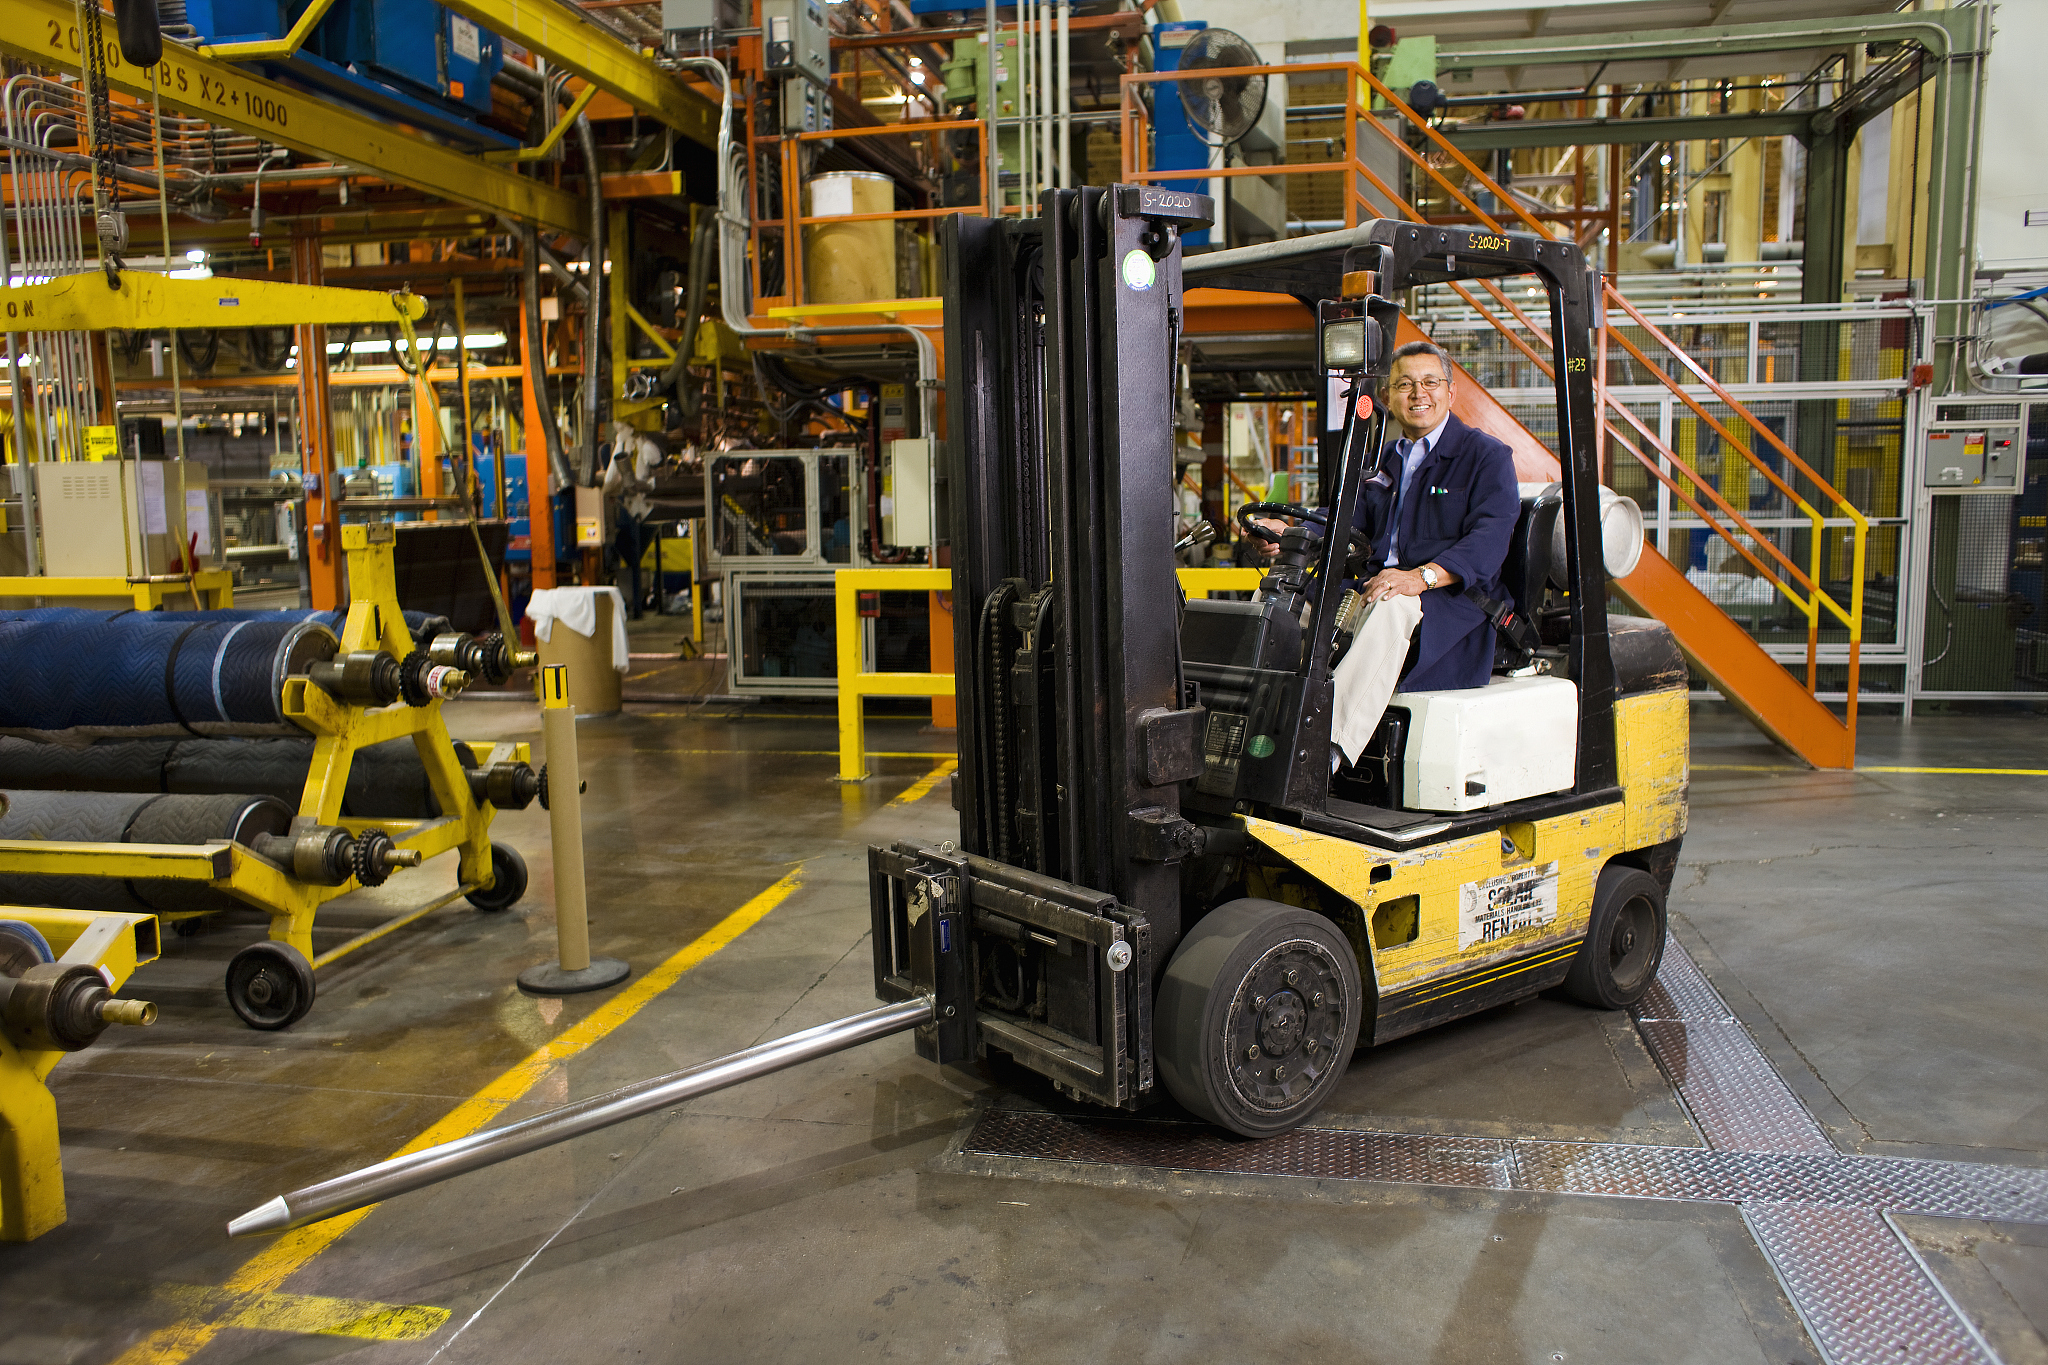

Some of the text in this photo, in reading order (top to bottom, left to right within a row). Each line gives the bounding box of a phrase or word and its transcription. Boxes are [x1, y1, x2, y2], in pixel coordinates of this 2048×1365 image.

[47, 19, 120, 69] 200
[1143, 192, 1191, 208] S-2020
[1468, 232, 1511, 252] S-2020-T
[0, 299, 34, 318] ON
[1567, 357, 1586, 373] #23
[1479, 870, 1535, 890] XCLUSIVE ROPERTY
[1475, 908, 1505, 923] MATERIALS
[1506, 901, 1531, 915] HANDL
[1482, 912, 1534, 943] REN
